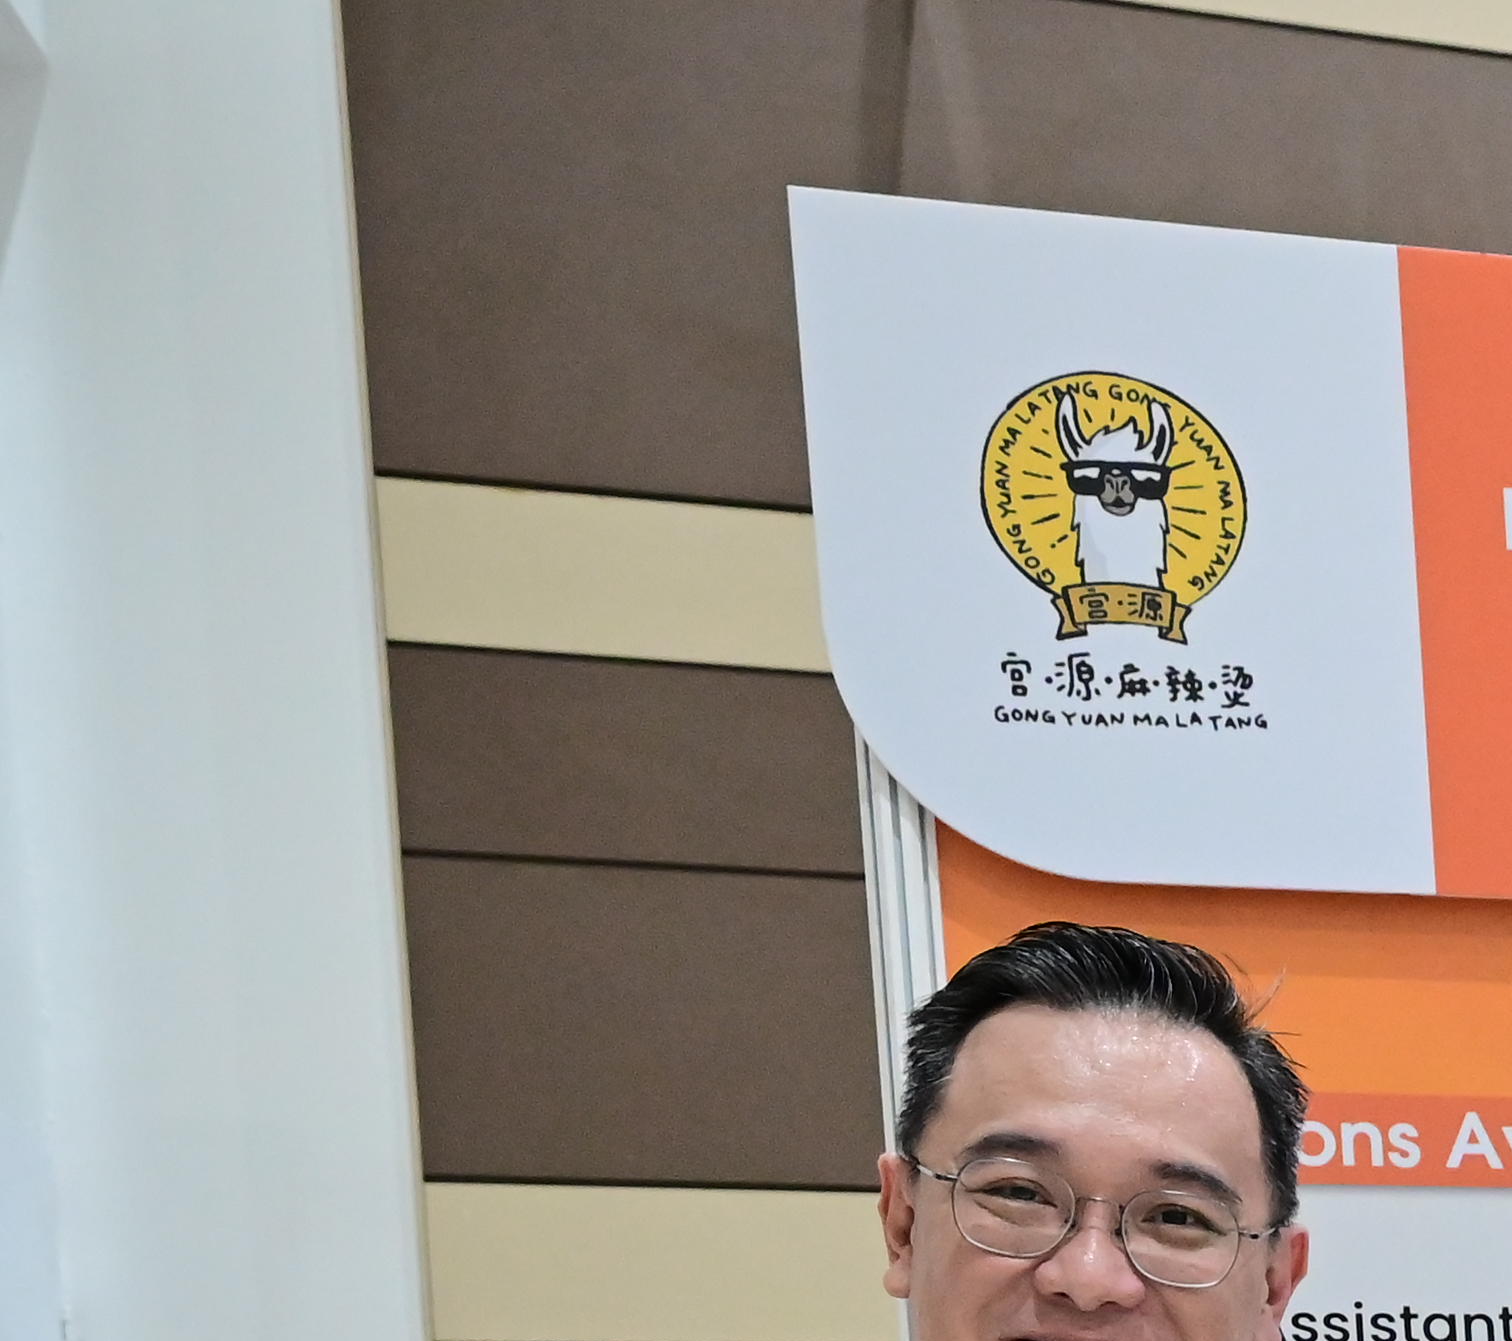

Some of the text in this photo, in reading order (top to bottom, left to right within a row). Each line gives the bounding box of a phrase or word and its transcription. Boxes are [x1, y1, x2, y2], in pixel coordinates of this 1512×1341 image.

[994, 706, 1056, 725] GONG
[1061, 711, 1125, 727] YUAN
[1209, 713, 1268, 731] TANG
